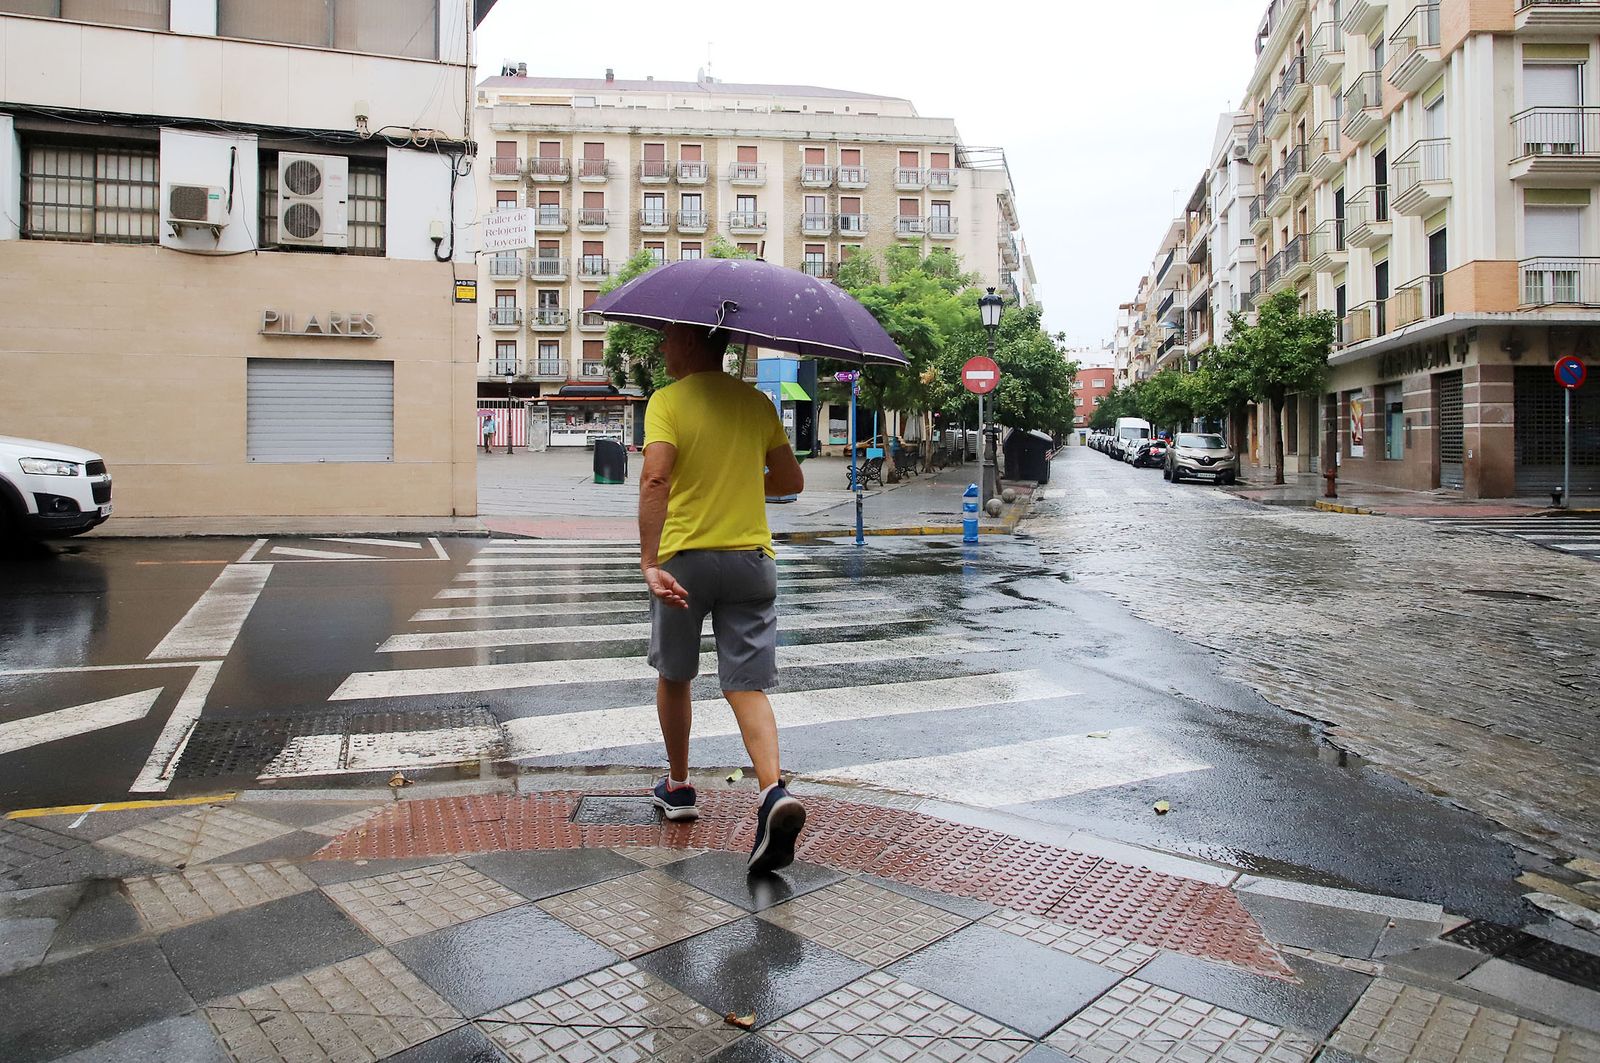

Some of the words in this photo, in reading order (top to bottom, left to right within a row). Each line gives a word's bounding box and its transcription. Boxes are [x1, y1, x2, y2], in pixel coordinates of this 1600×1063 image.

[487, 216, 511, 226] Taller
[513, 212, 527, 222] de
[261, 309, 376, 336] PILARES
